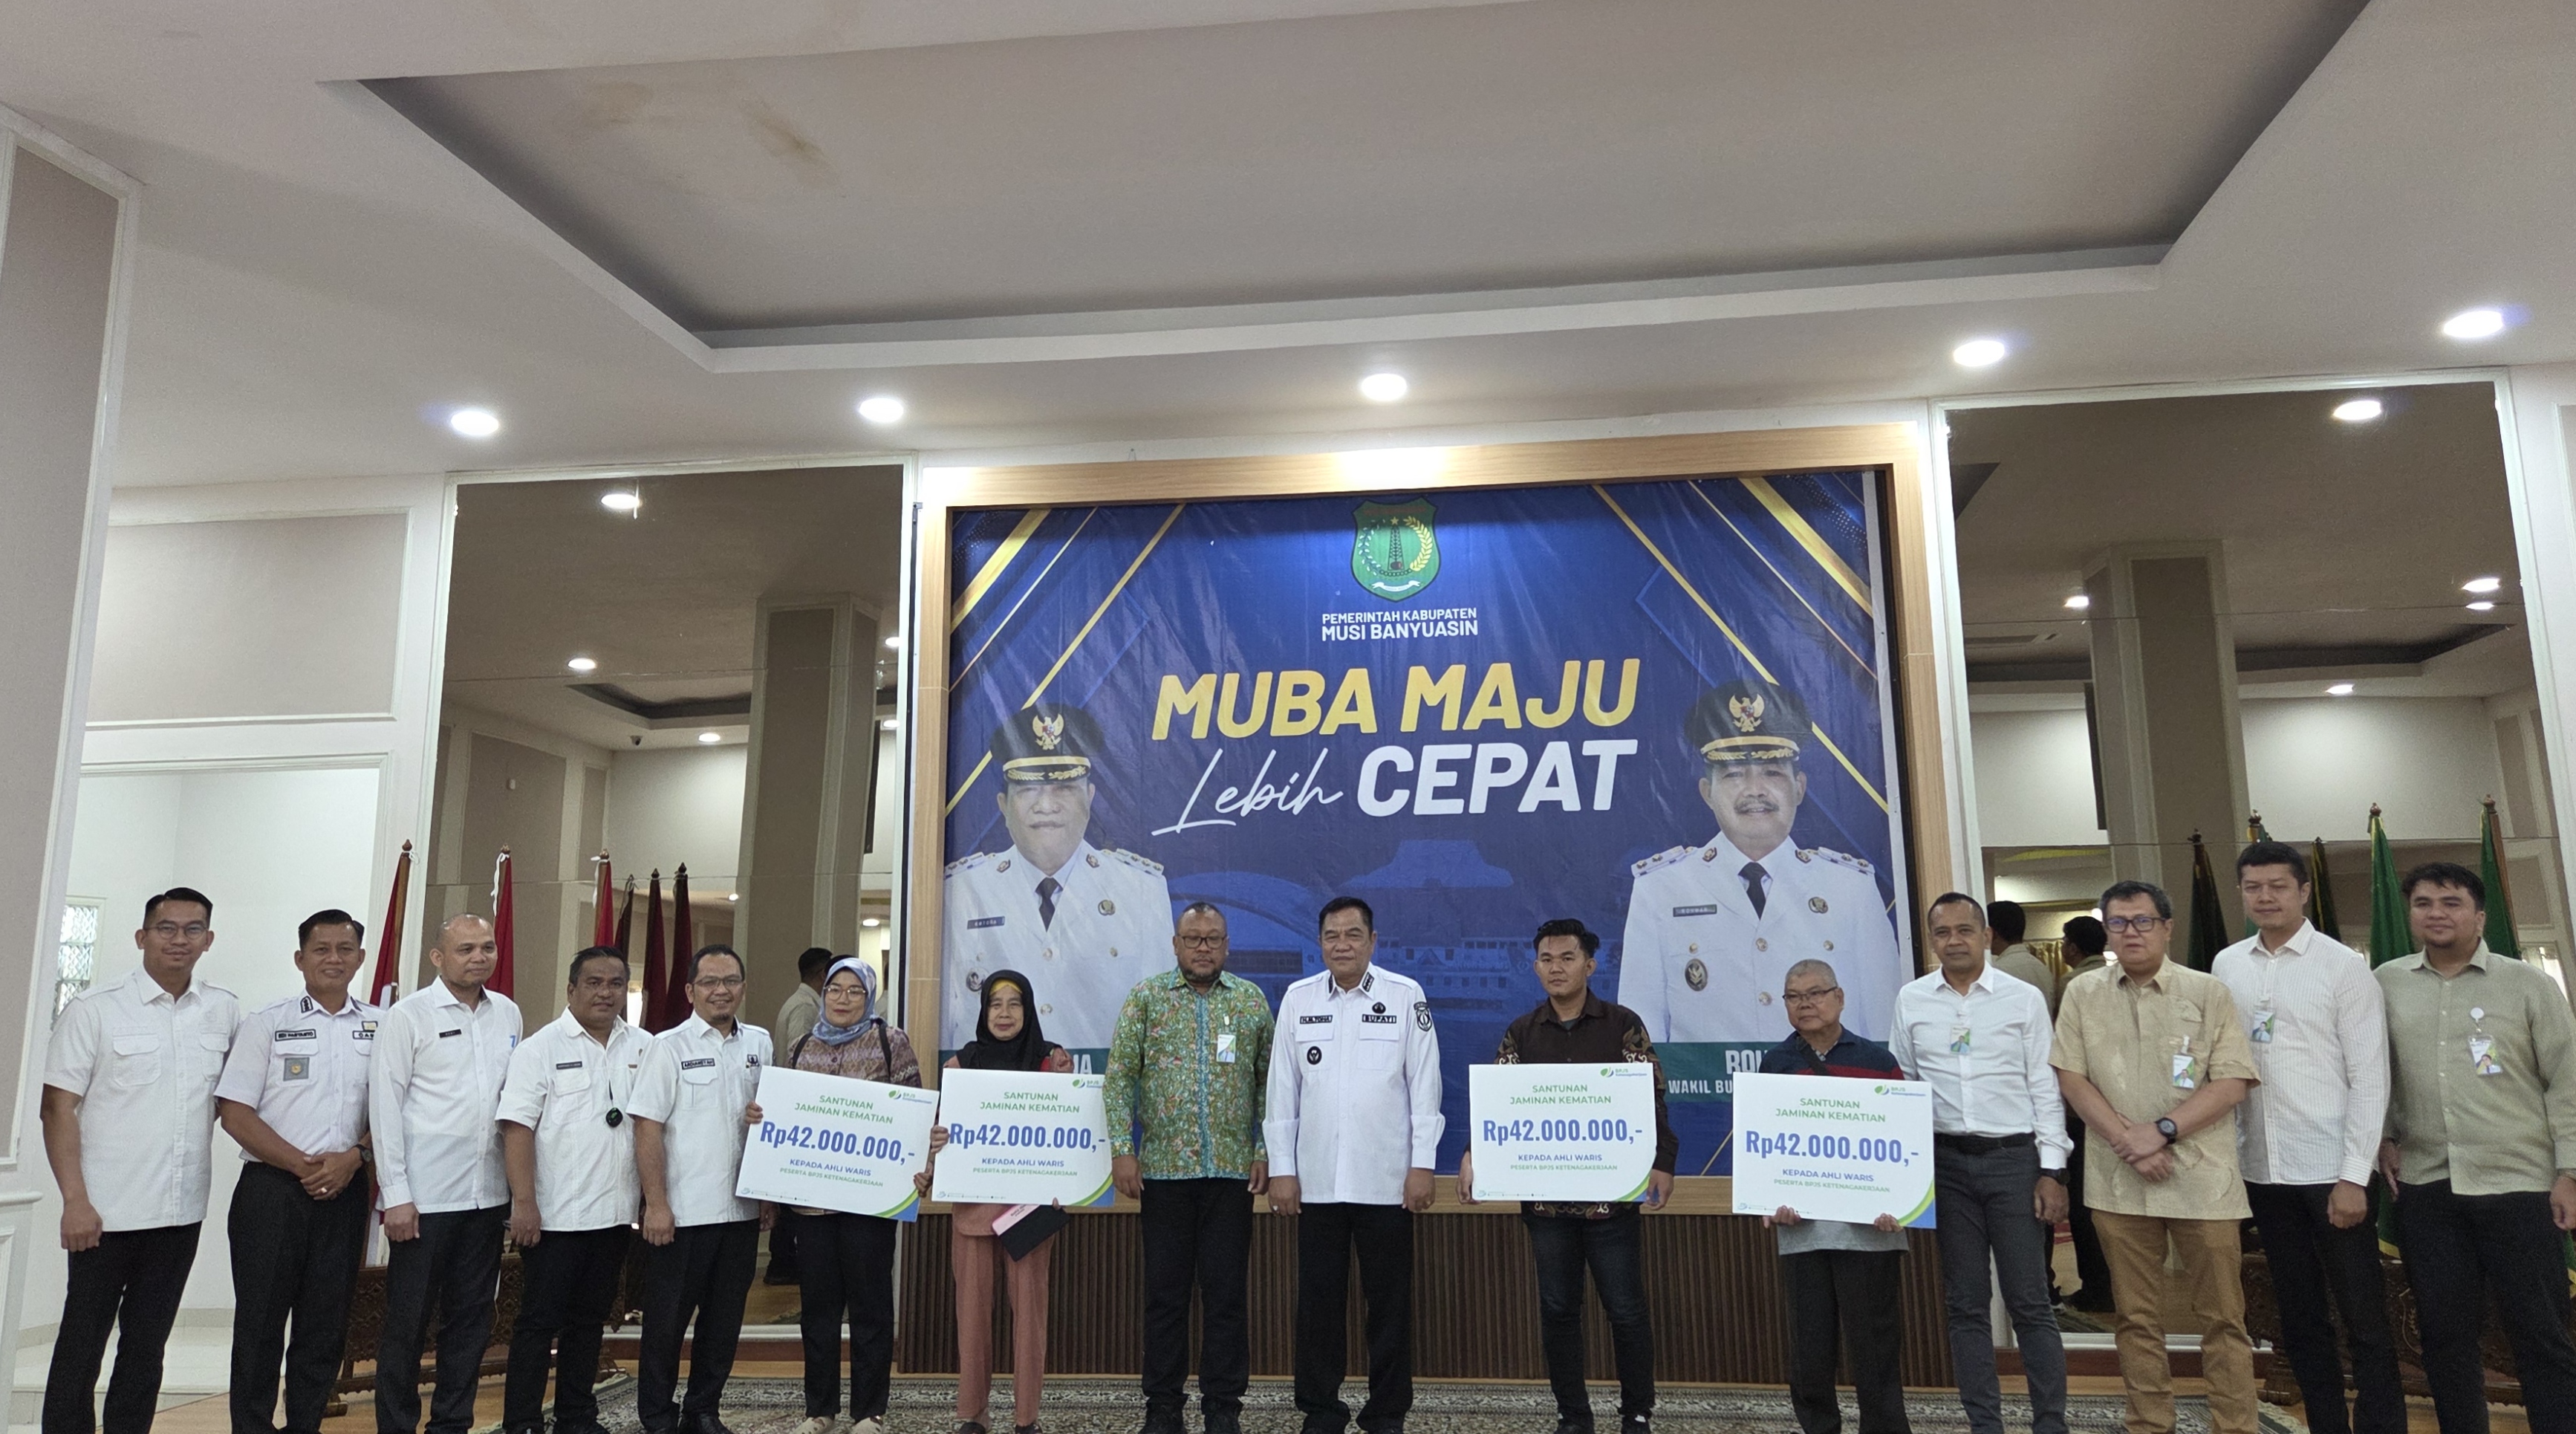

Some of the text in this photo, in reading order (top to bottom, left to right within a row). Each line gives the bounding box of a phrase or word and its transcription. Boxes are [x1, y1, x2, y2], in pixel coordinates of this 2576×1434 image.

[1322, 607, 1477, 624] PEMERINTAH KABUPATEN
[1321, 620, 1478, 641] MUSI BANYUASIN
[1151, 658, 1640, 741] MUBA MAJU
[1151, 739, 1639, 836] Lebih CEPAT
[1532, 1085, 1587, 1093] SANTUNAN
[1668, 1080, 1711, 1094] WAKIL
[819, 1094, 874, 1110] SANTUNAN
[1004, 1091, 1058, 1101] SANTUNAN
[1510, 1096, 1611, 1105] JAMINAN KEMATIAN
[1800, 1097, 1860, 1109] SANTUNAN
[794, 1103, 893, 1124] JAMINAN KEMATIAN
[980, 1102, 1080, 1113] JAMINAN KEMATIAN
[1775, 1109, 1886, 1123] JAMINAN KEMATIAN
[949, 1123, 1105, 1152] Rp42.000.000,-
[1483, 1119, 1642, 1146] Rp42.000.000,-
[760, 1120, 914, 1165] Rp42.000.000,-
[1746, 1130, 1919, 1167] Rp42.000.000,-
[790, 1159, 871, 1176] KEPADA AHLI WARIS
[982, 1158, 1015, 1166] KEPADA
[1783, 1169, 1874, 1182] KEPADA AHLI WARIS
